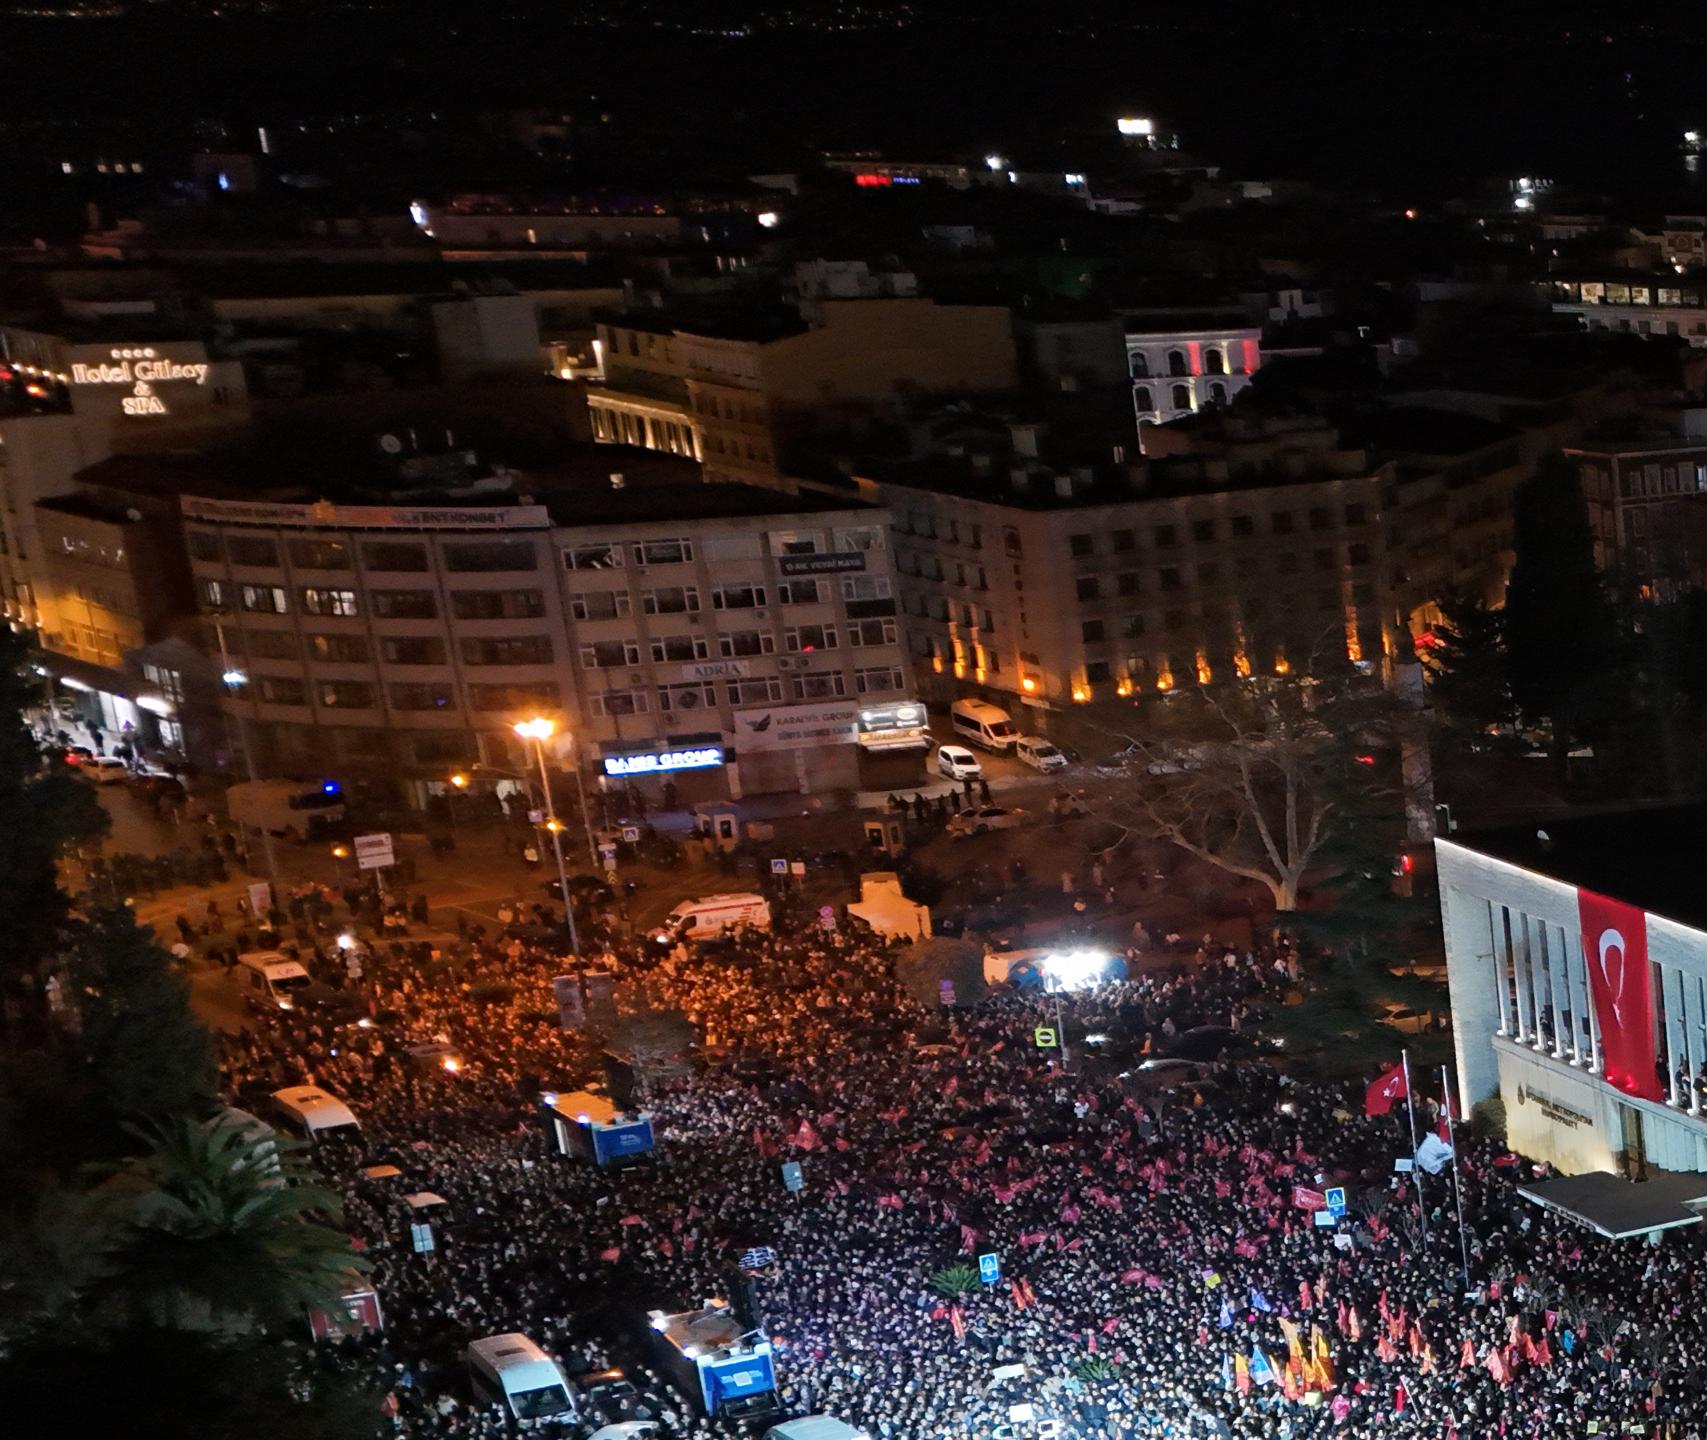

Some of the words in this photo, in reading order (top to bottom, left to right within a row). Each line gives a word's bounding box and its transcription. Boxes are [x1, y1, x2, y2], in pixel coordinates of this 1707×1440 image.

[72, 362, 132, 383] Hotel
[133, 380, 152, 396] &
[122, 396, 166, 415] SPA
[659, 749, 720, 768] GROUP
